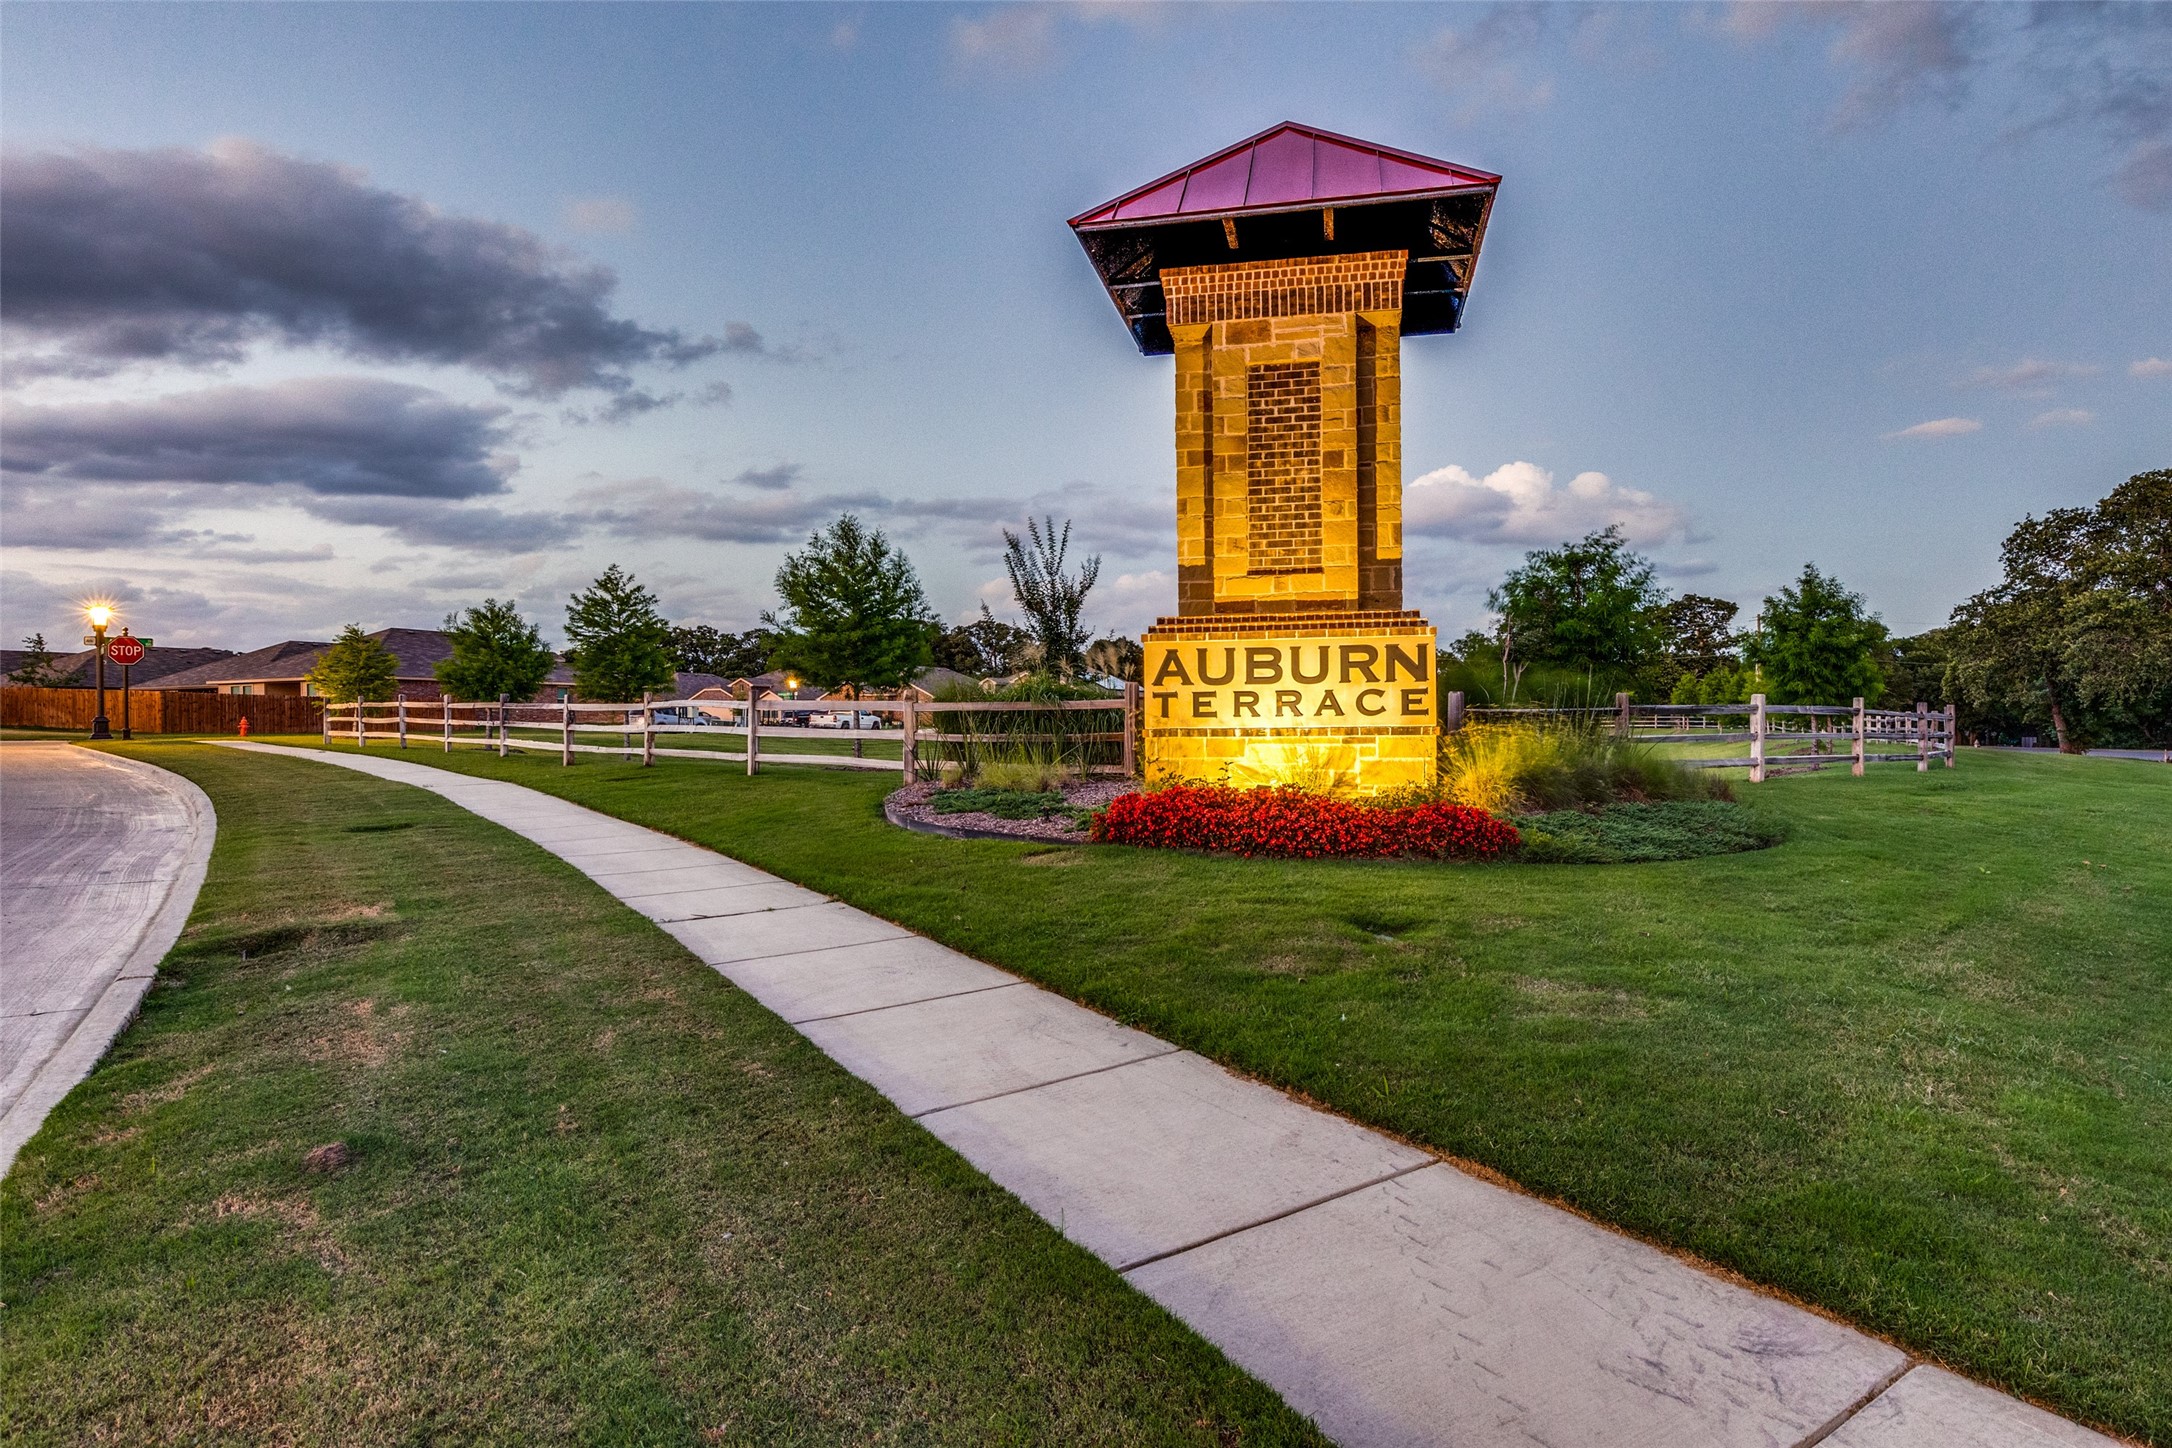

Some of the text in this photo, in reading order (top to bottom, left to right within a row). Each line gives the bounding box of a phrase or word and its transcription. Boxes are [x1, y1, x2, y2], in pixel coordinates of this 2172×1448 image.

[110, 645, 142, 656] STOP
[1151, 643, 1430, 686] AUBURN
[1152, 687, 1430, 718] TERRACE
